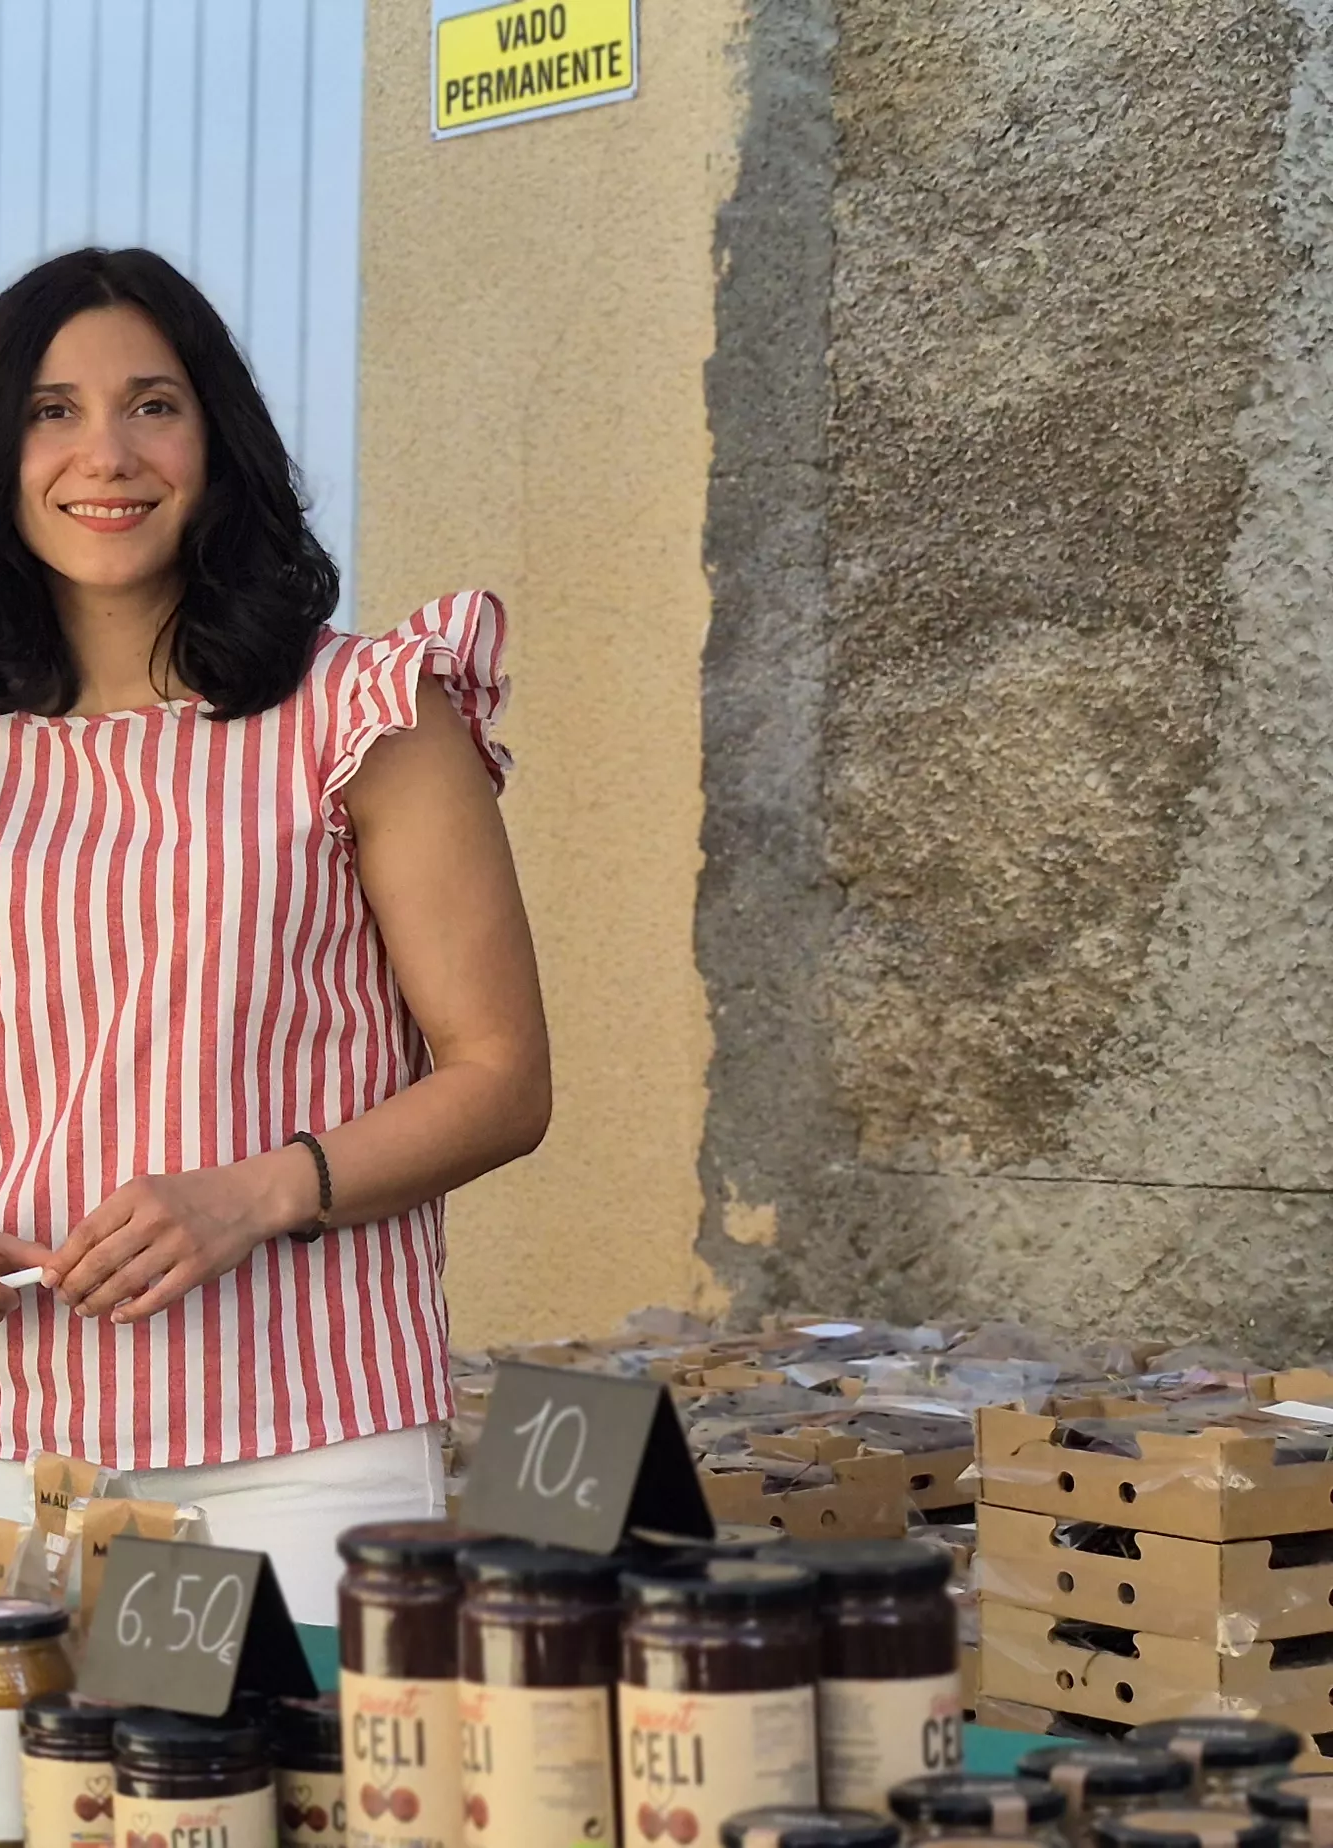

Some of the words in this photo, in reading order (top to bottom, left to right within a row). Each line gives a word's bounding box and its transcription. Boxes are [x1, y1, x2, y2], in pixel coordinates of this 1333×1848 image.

[496, 3, 567, 53] VADO
[445, 40, 623, 116] PERMANENTE
[352, 1712, 426, 1768] CELI
[629, 1726, 704, 1787] CELI
